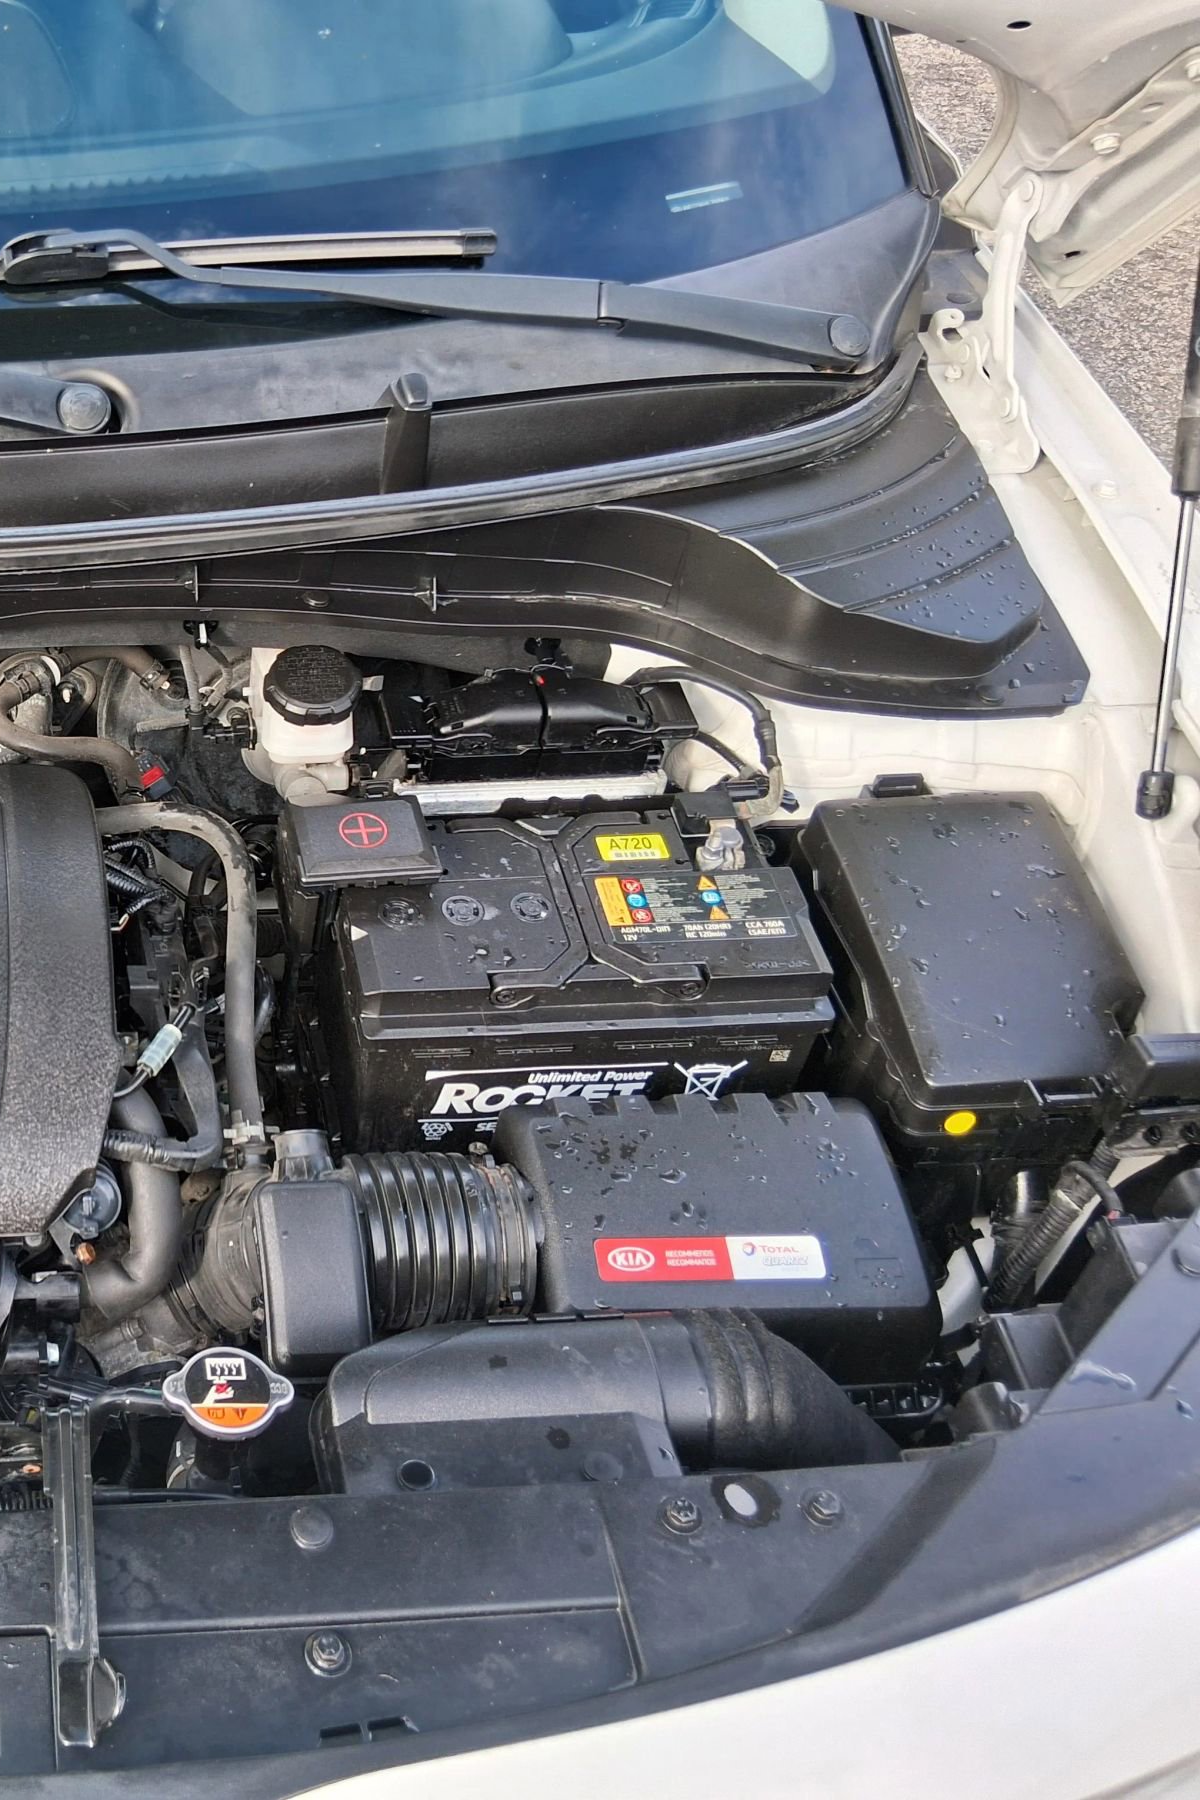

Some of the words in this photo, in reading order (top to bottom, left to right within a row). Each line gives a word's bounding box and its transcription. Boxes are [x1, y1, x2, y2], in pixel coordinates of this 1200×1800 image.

[609, 836, 652, 850] A720
[683, 923, 704, 931] 70Ah
[745, 921, 761, 929] CCA
[699, 930, 726, 938] 120min
[527, 1071, 601, 1085] Unlimited
[603, 1070, 653, 1082] Power
[430, 1082, 646, 1115] ROCKET
[759, 1244, 800, 1254] TOTAL
[615, 1252, 648, 1266] KIA
[762, 1255, 809, 1267] QUARTZ
